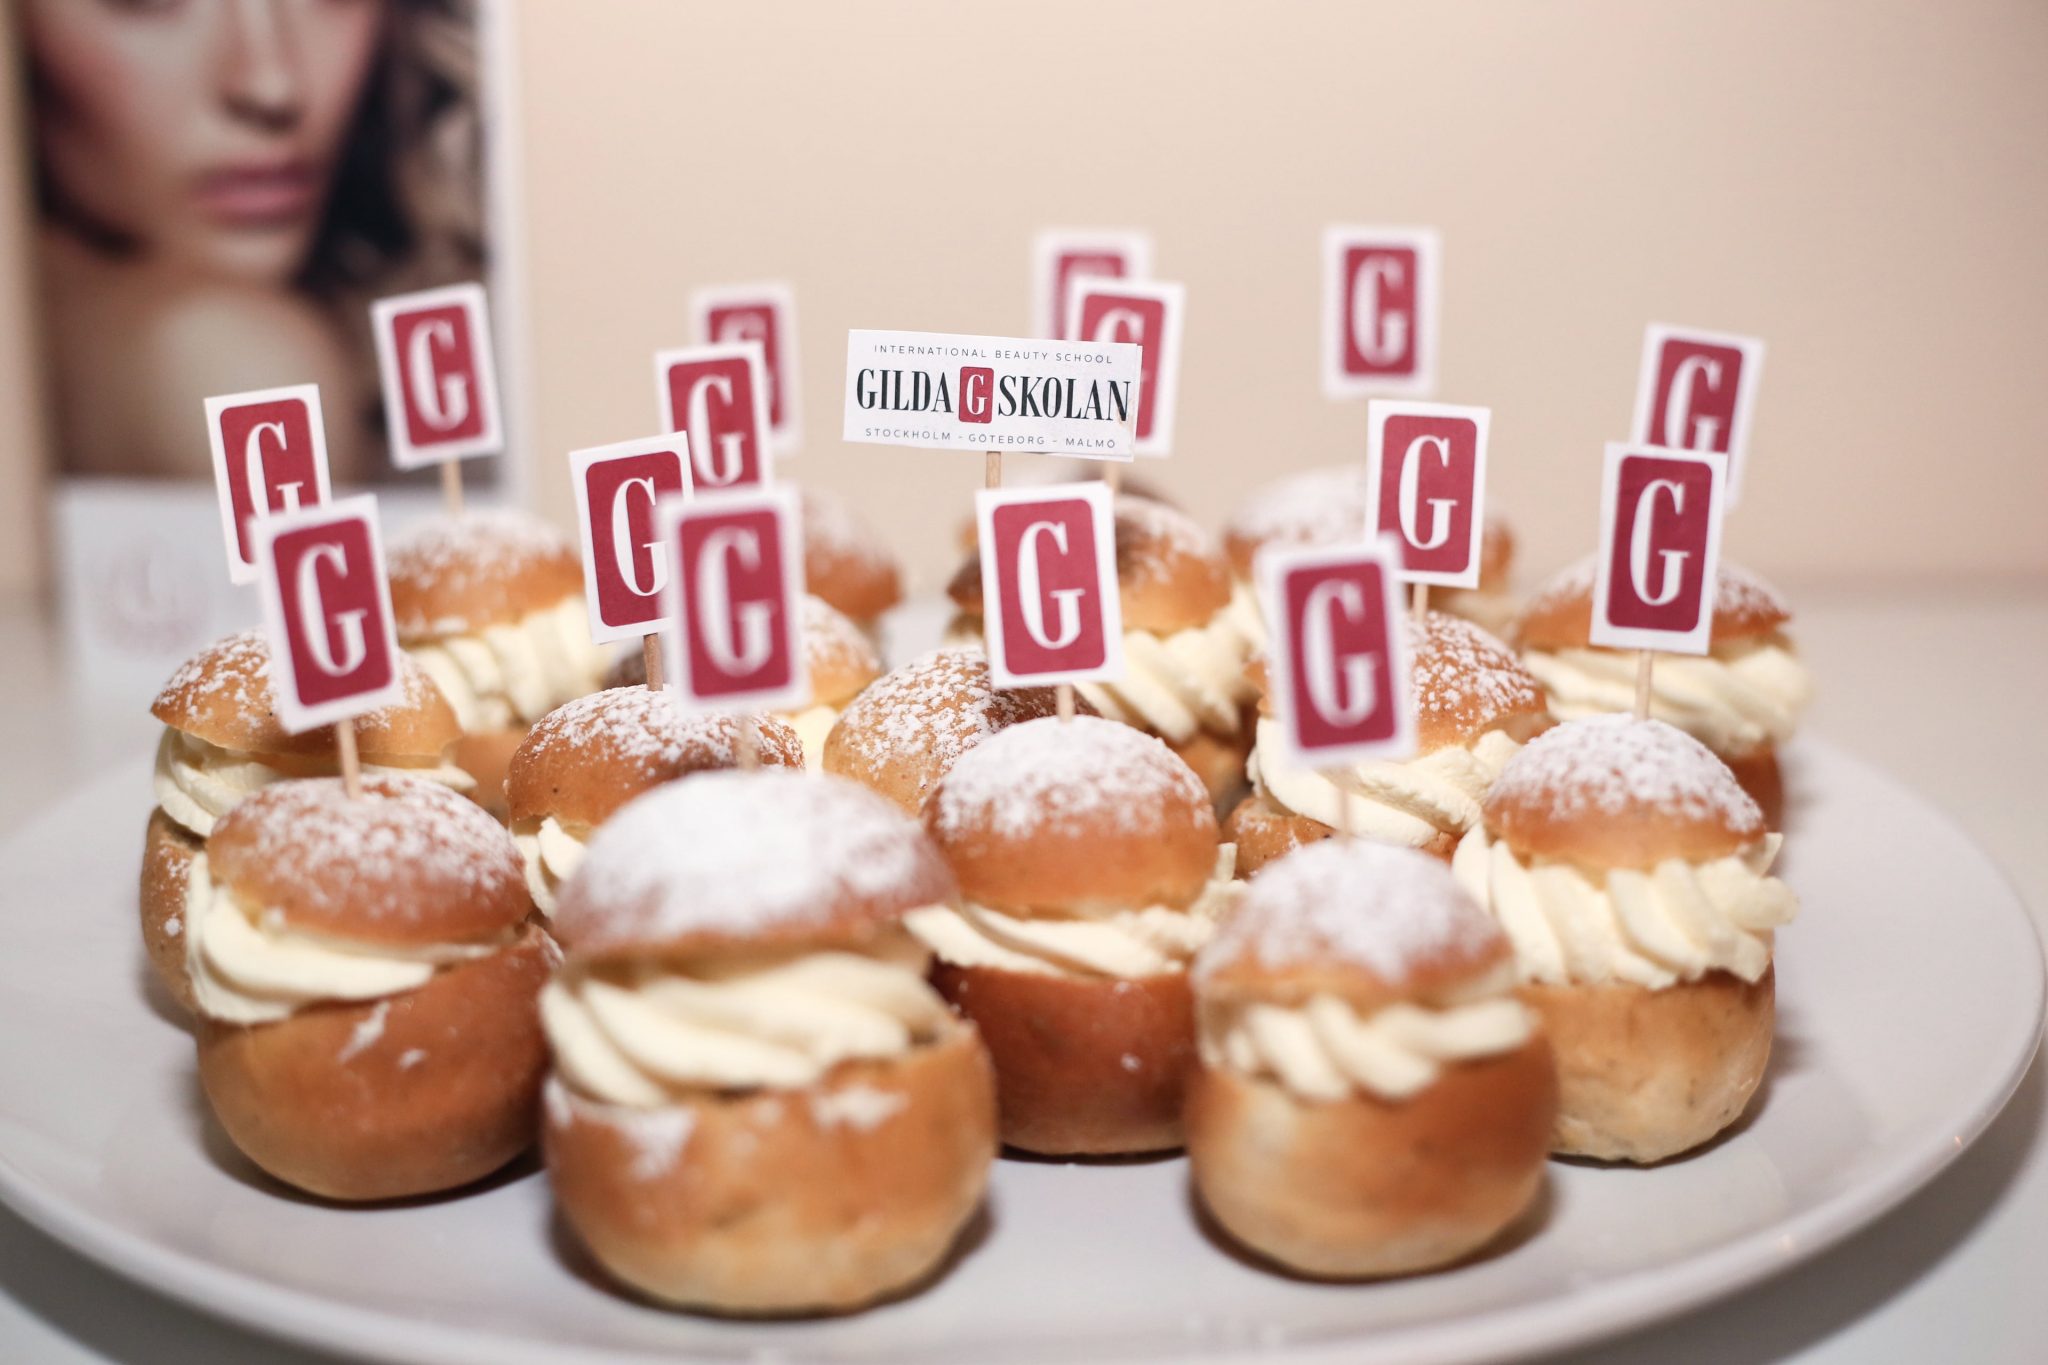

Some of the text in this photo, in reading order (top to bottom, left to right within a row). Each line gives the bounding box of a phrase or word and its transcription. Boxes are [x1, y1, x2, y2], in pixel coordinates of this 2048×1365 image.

[873, 344, 1113, 364] INTERNATIONAL BEAUTY SCHOOL
[1352, 254, 1408, 367] G
[407, 318, 470, 432] G
[687, 375, 745, 487] G
[856, 368, 1132, 422] GILDA G SKOLAN
[865, 428, 951, 441] STOCKHOLM
[1398, 434, 1458, 550] G
[1016, 520, 1086, 650] G
[1629, 478, 1690, 606] G
[295, 542, 369, 677] G
[695, 525, 777, 676] G
[1301, 577, 1379, 728] G
